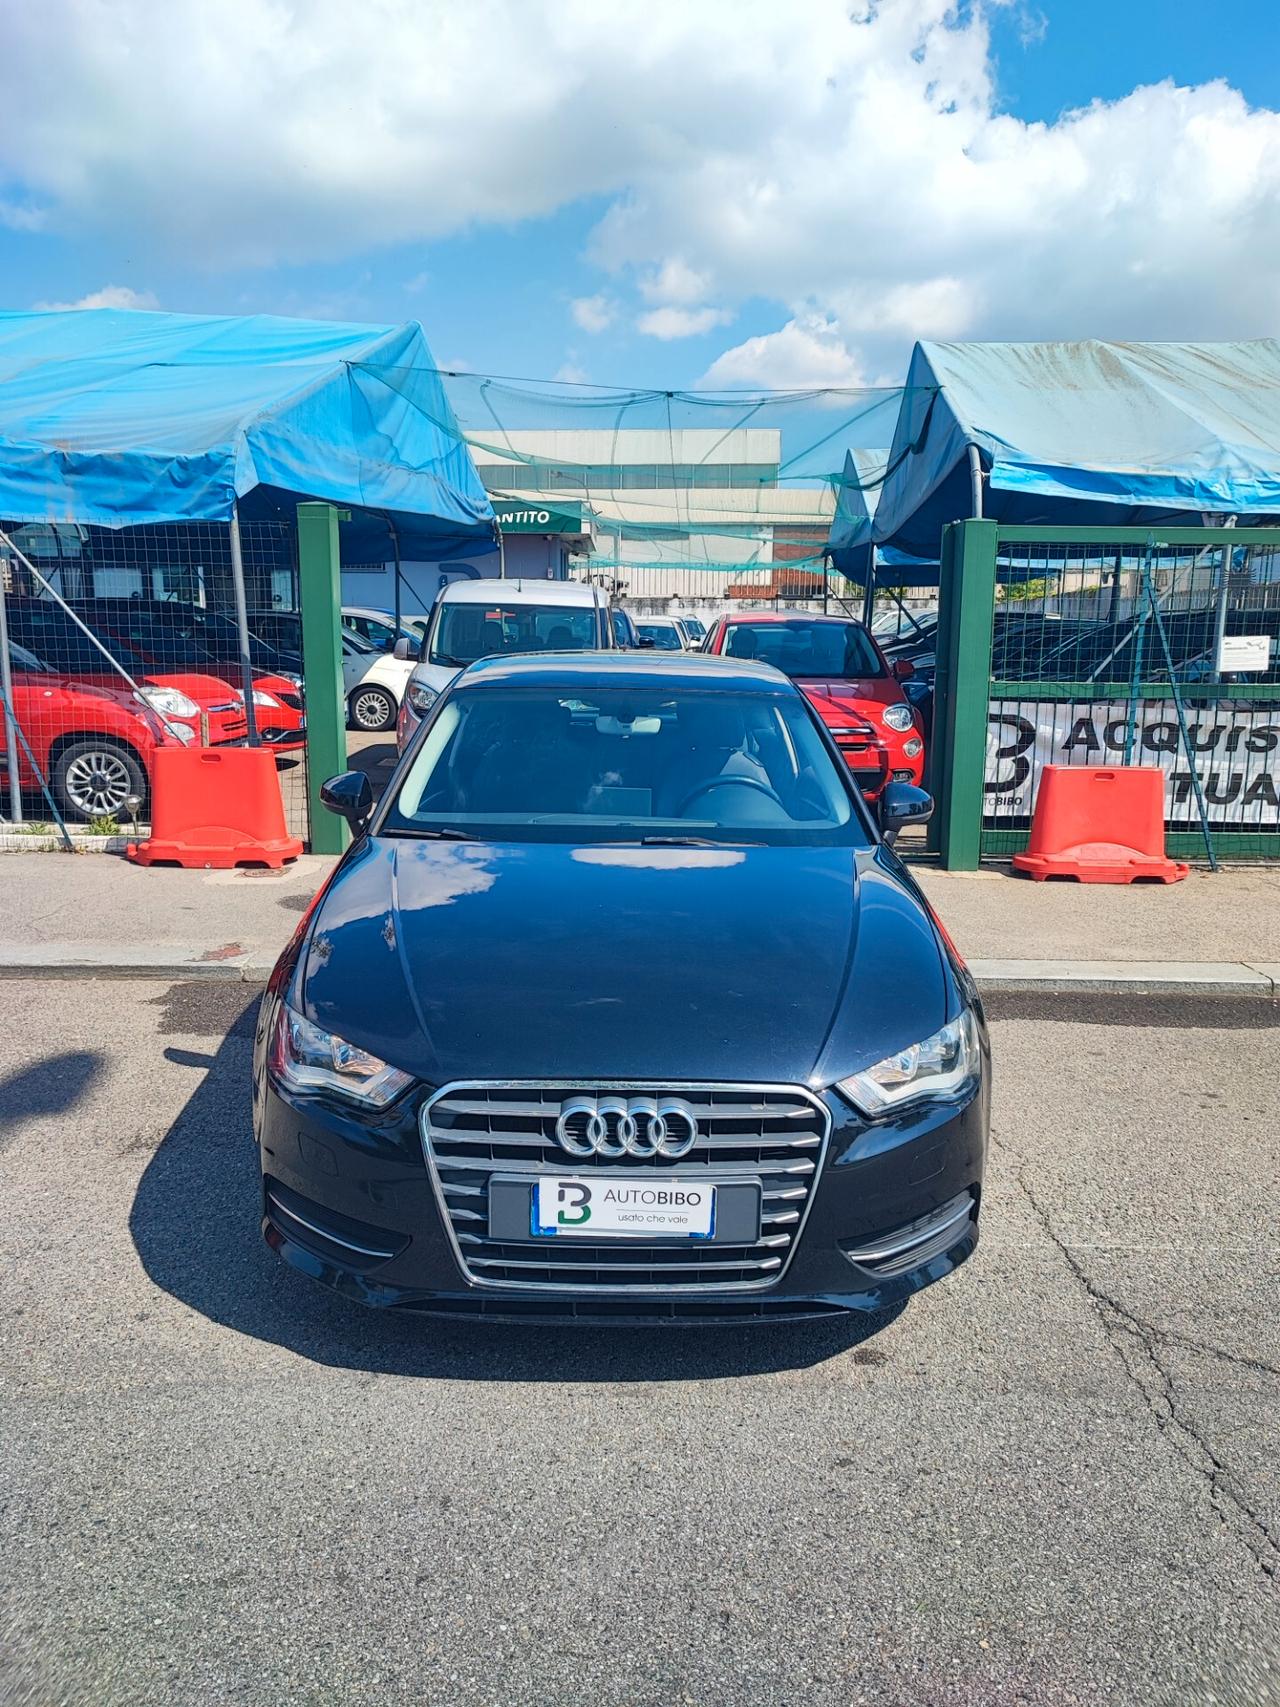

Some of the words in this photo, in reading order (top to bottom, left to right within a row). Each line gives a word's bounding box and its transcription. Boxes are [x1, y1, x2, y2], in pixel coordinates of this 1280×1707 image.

[1062, 717, 1280, 754] ACQUIS
[1169, 772, 1279, 806] TUA
[604, 1189, 701, 1206] AUTOBIBO
[618, 1214, 644, 1223] usato
[646, 1214, 666, 1223] che
[668, 1215, 688, 1224] vale
